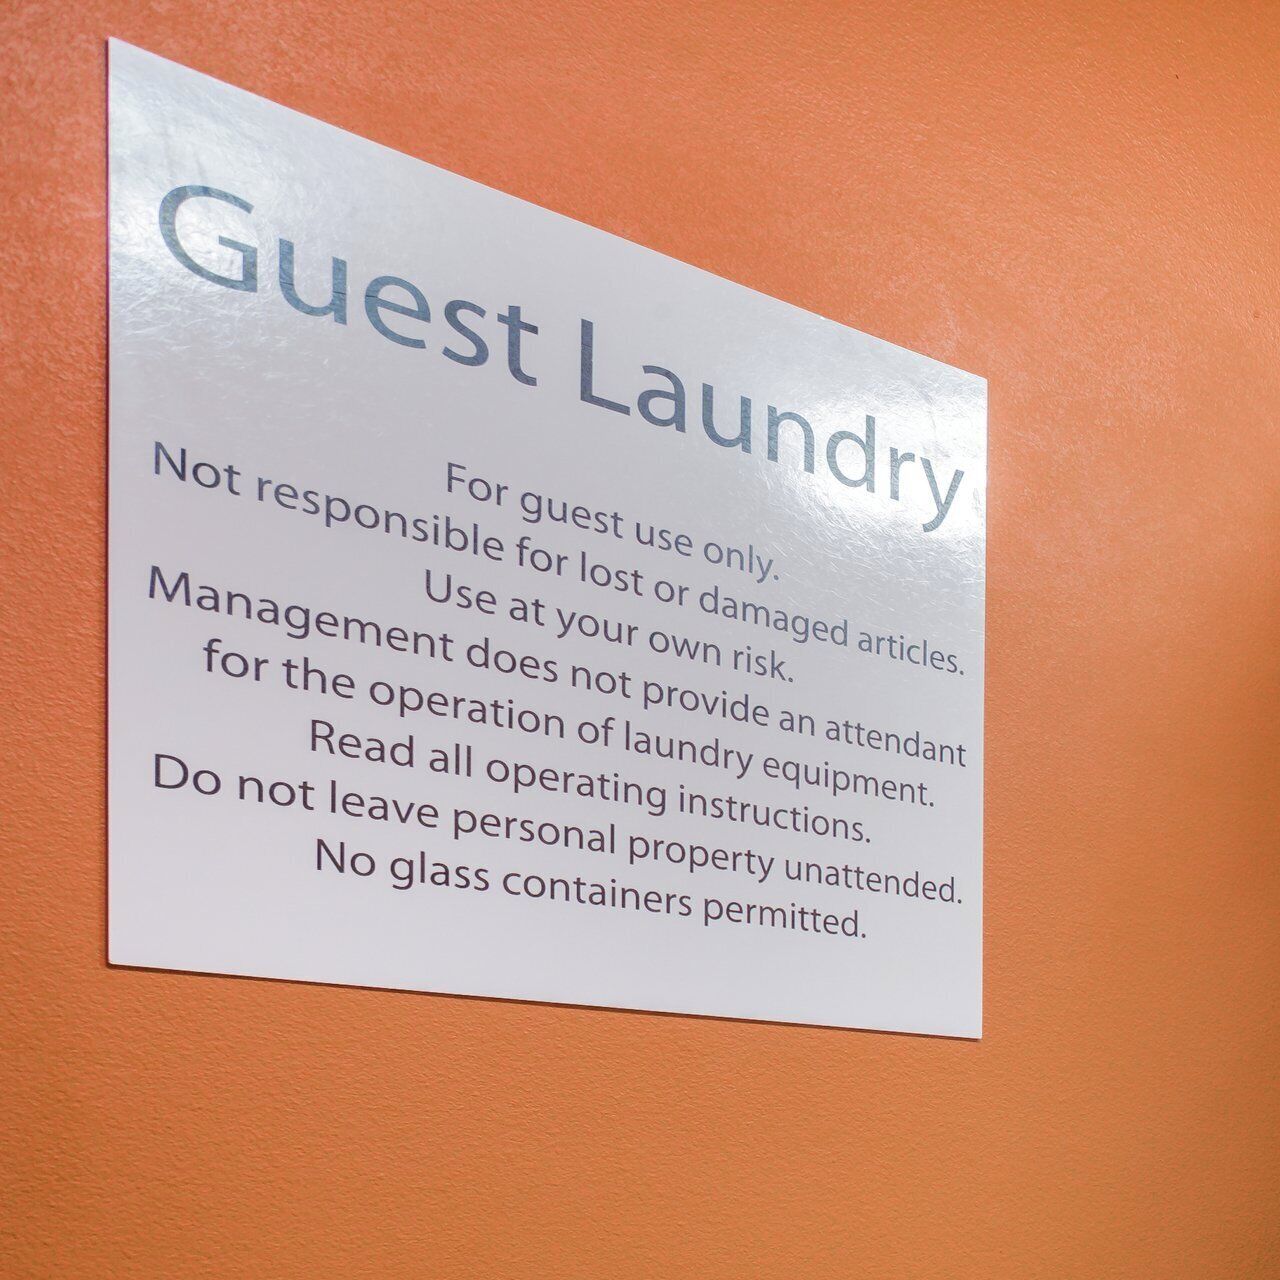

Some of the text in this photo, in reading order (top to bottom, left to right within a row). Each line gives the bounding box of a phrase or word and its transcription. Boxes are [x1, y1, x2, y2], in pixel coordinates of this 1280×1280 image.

[158, 184, 965, 533] Guest Laundry
[154, 440, 966, 678] Not responsible for lost or damaged articles.
[447, 461, 779, 584] For guest use only.
[148, 564, 967, 768] Management does not provide an attendant
[425, 568, 794, 683] Use at your own risk.
[202, 637, 935, 808] for the operation of laundry equipment.
[310, 719, 871, 844] Read all operating instructions.
[154, 753, 963, 905] Do not leave personal property unattended.
[316, 838, 867, 939] No glass containers permitted.
